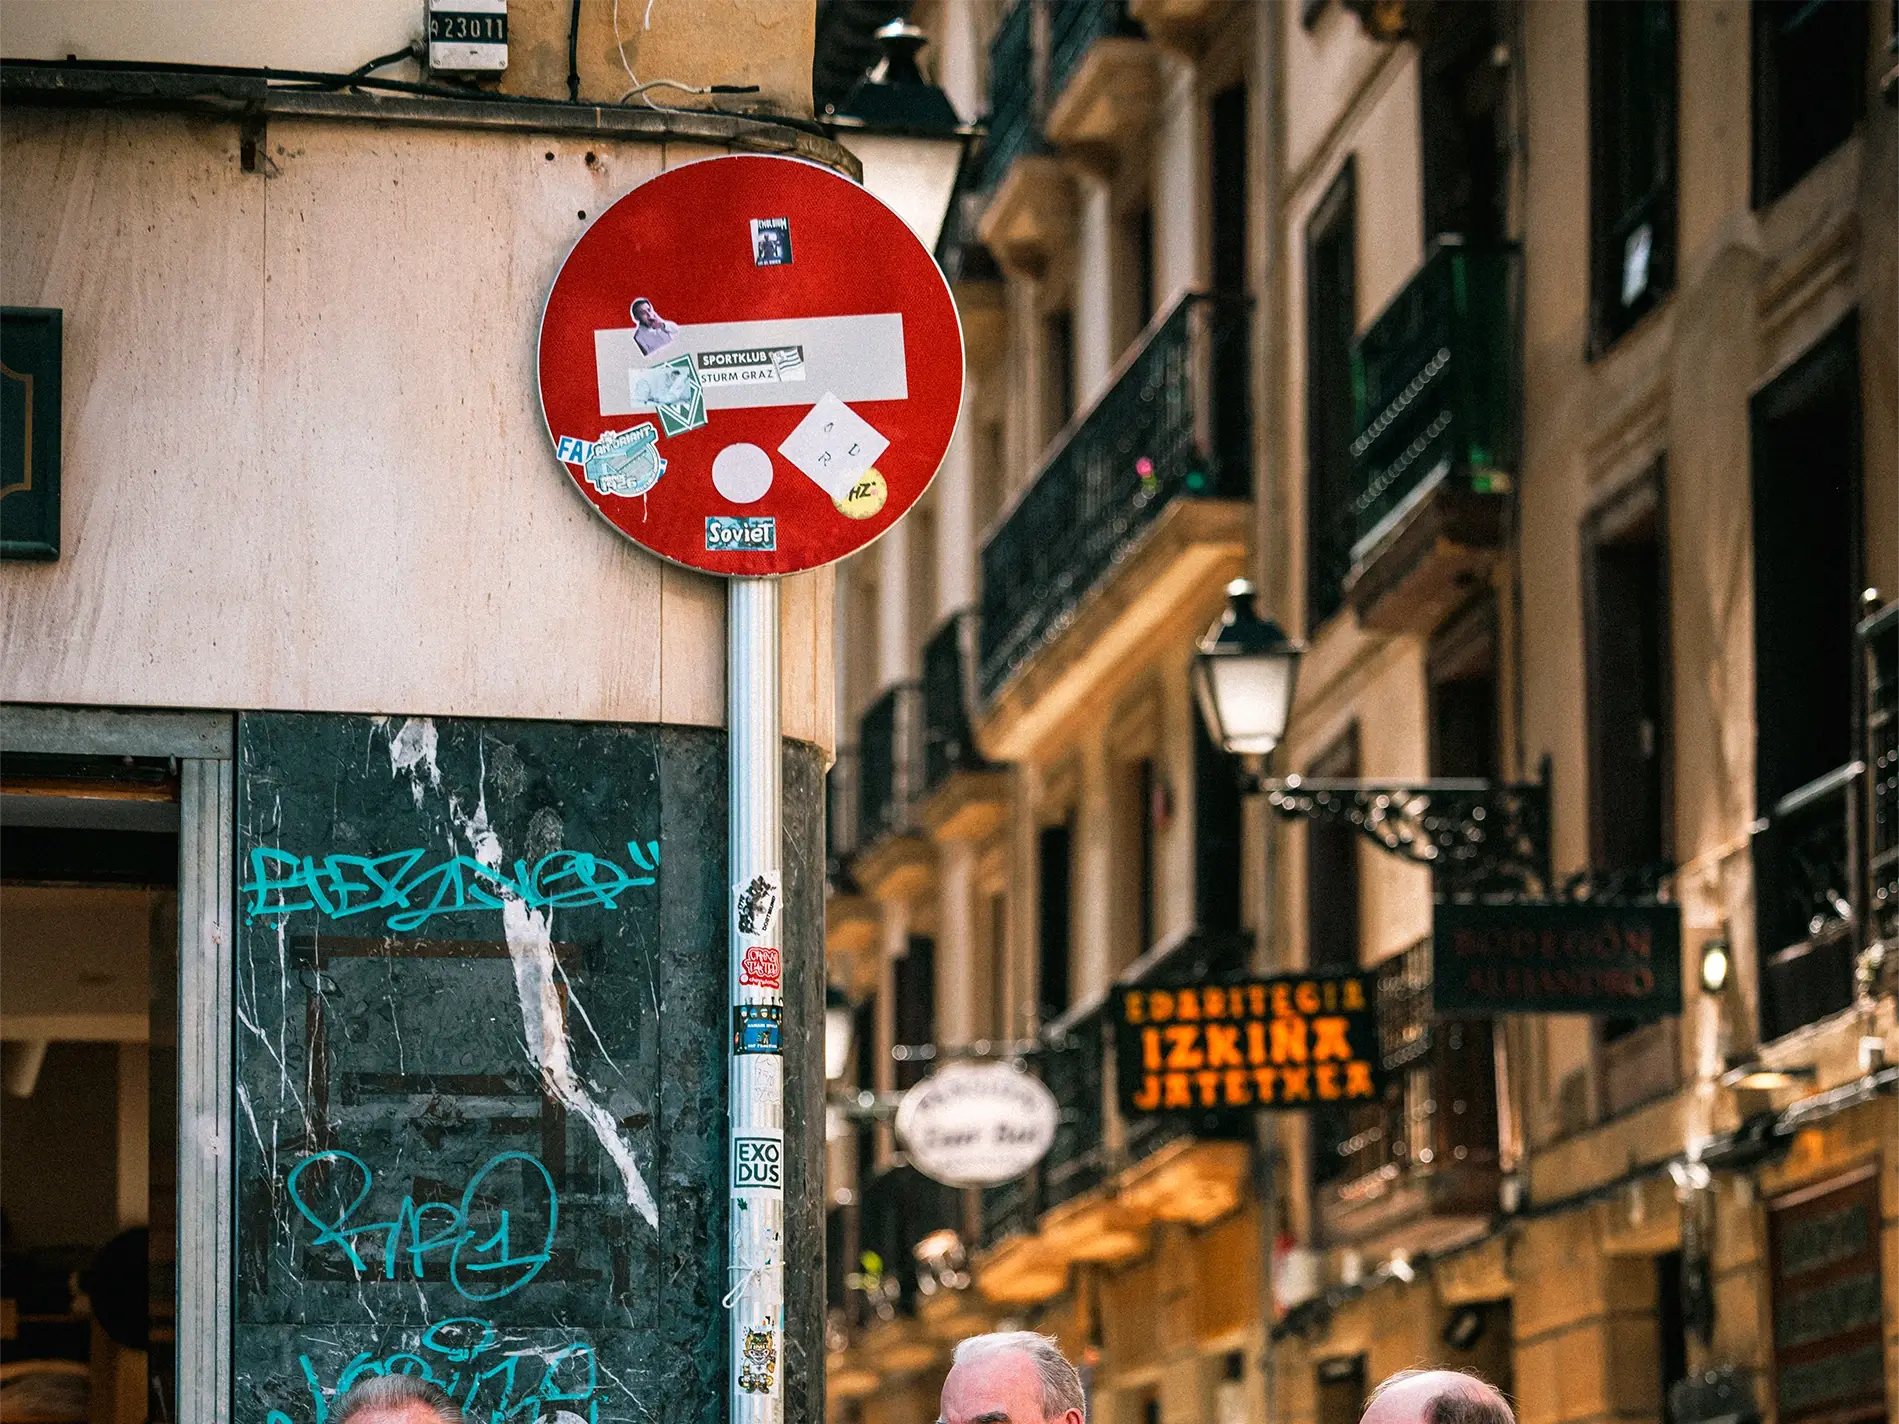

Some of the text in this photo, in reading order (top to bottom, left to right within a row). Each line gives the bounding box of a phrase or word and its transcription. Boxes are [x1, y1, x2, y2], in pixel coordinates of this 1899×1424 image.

[702, 351, 767, 366] SPORTKLUB
[701, 370, 773, 383] STURM GRAZ
[739, 1143, 780, 1163] EXO
[739, 1163, 780, 1183] DUS
